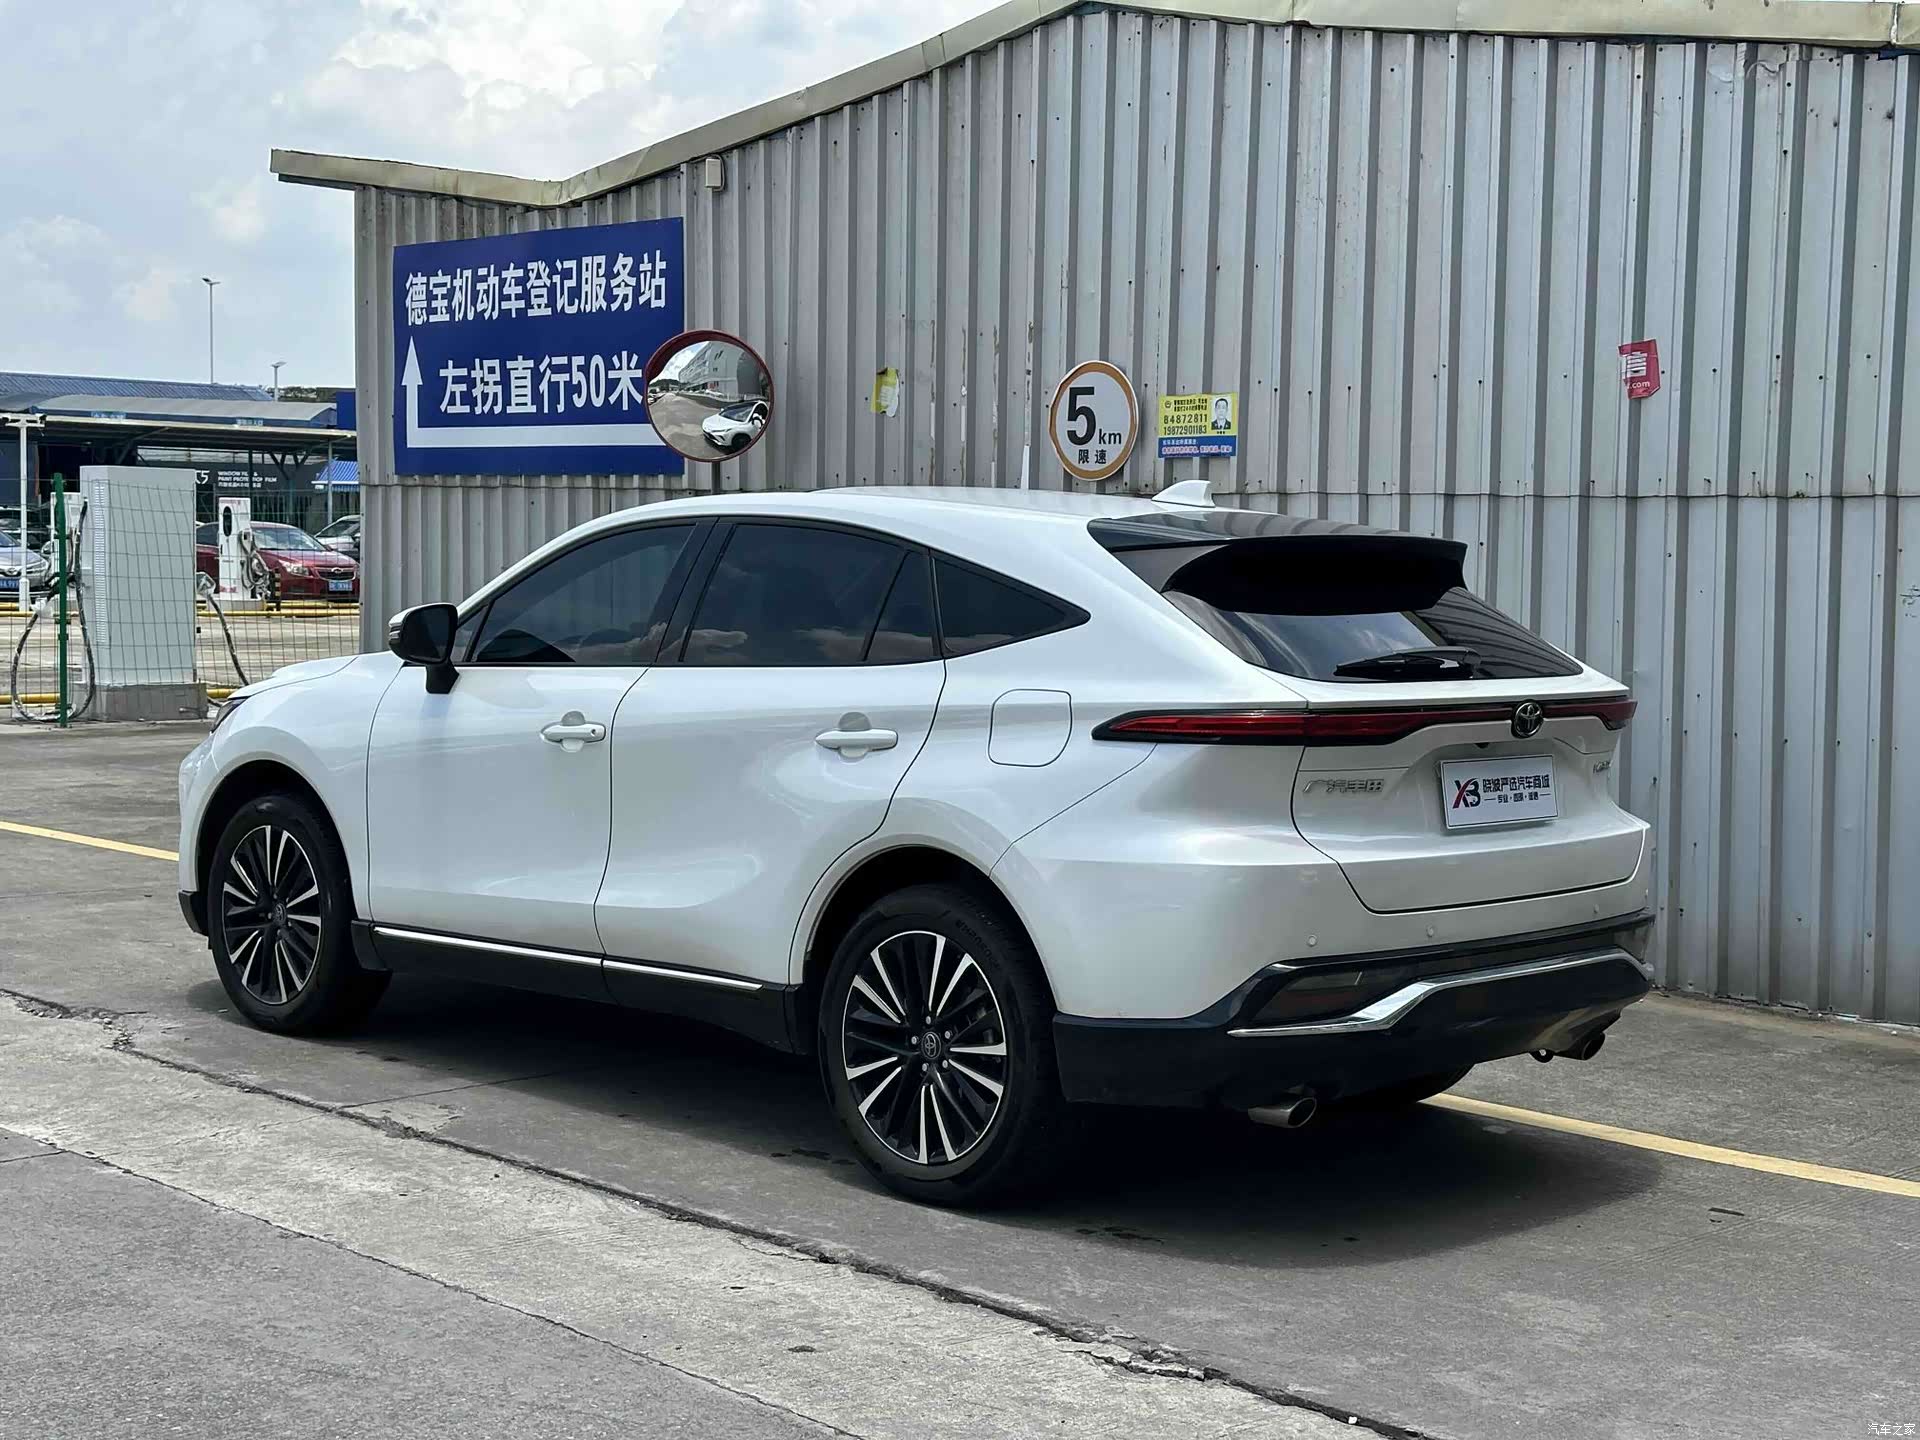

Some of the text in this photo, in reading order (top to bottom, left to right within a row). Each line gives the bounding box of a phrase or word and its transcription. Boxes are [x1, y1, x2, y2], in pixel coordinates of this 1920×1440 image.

[404, 249, 667, 327] 德宝机动车登记服务站
[439, 350, 644, 415] 左拐直行50米
[1066, 386, 1122, 446] 5 km
[1163, 413, 1208, 425] 84872811
[1163, 424, 1208, 436] 19872901183
[1077, 448, 1107, 465] 限速
